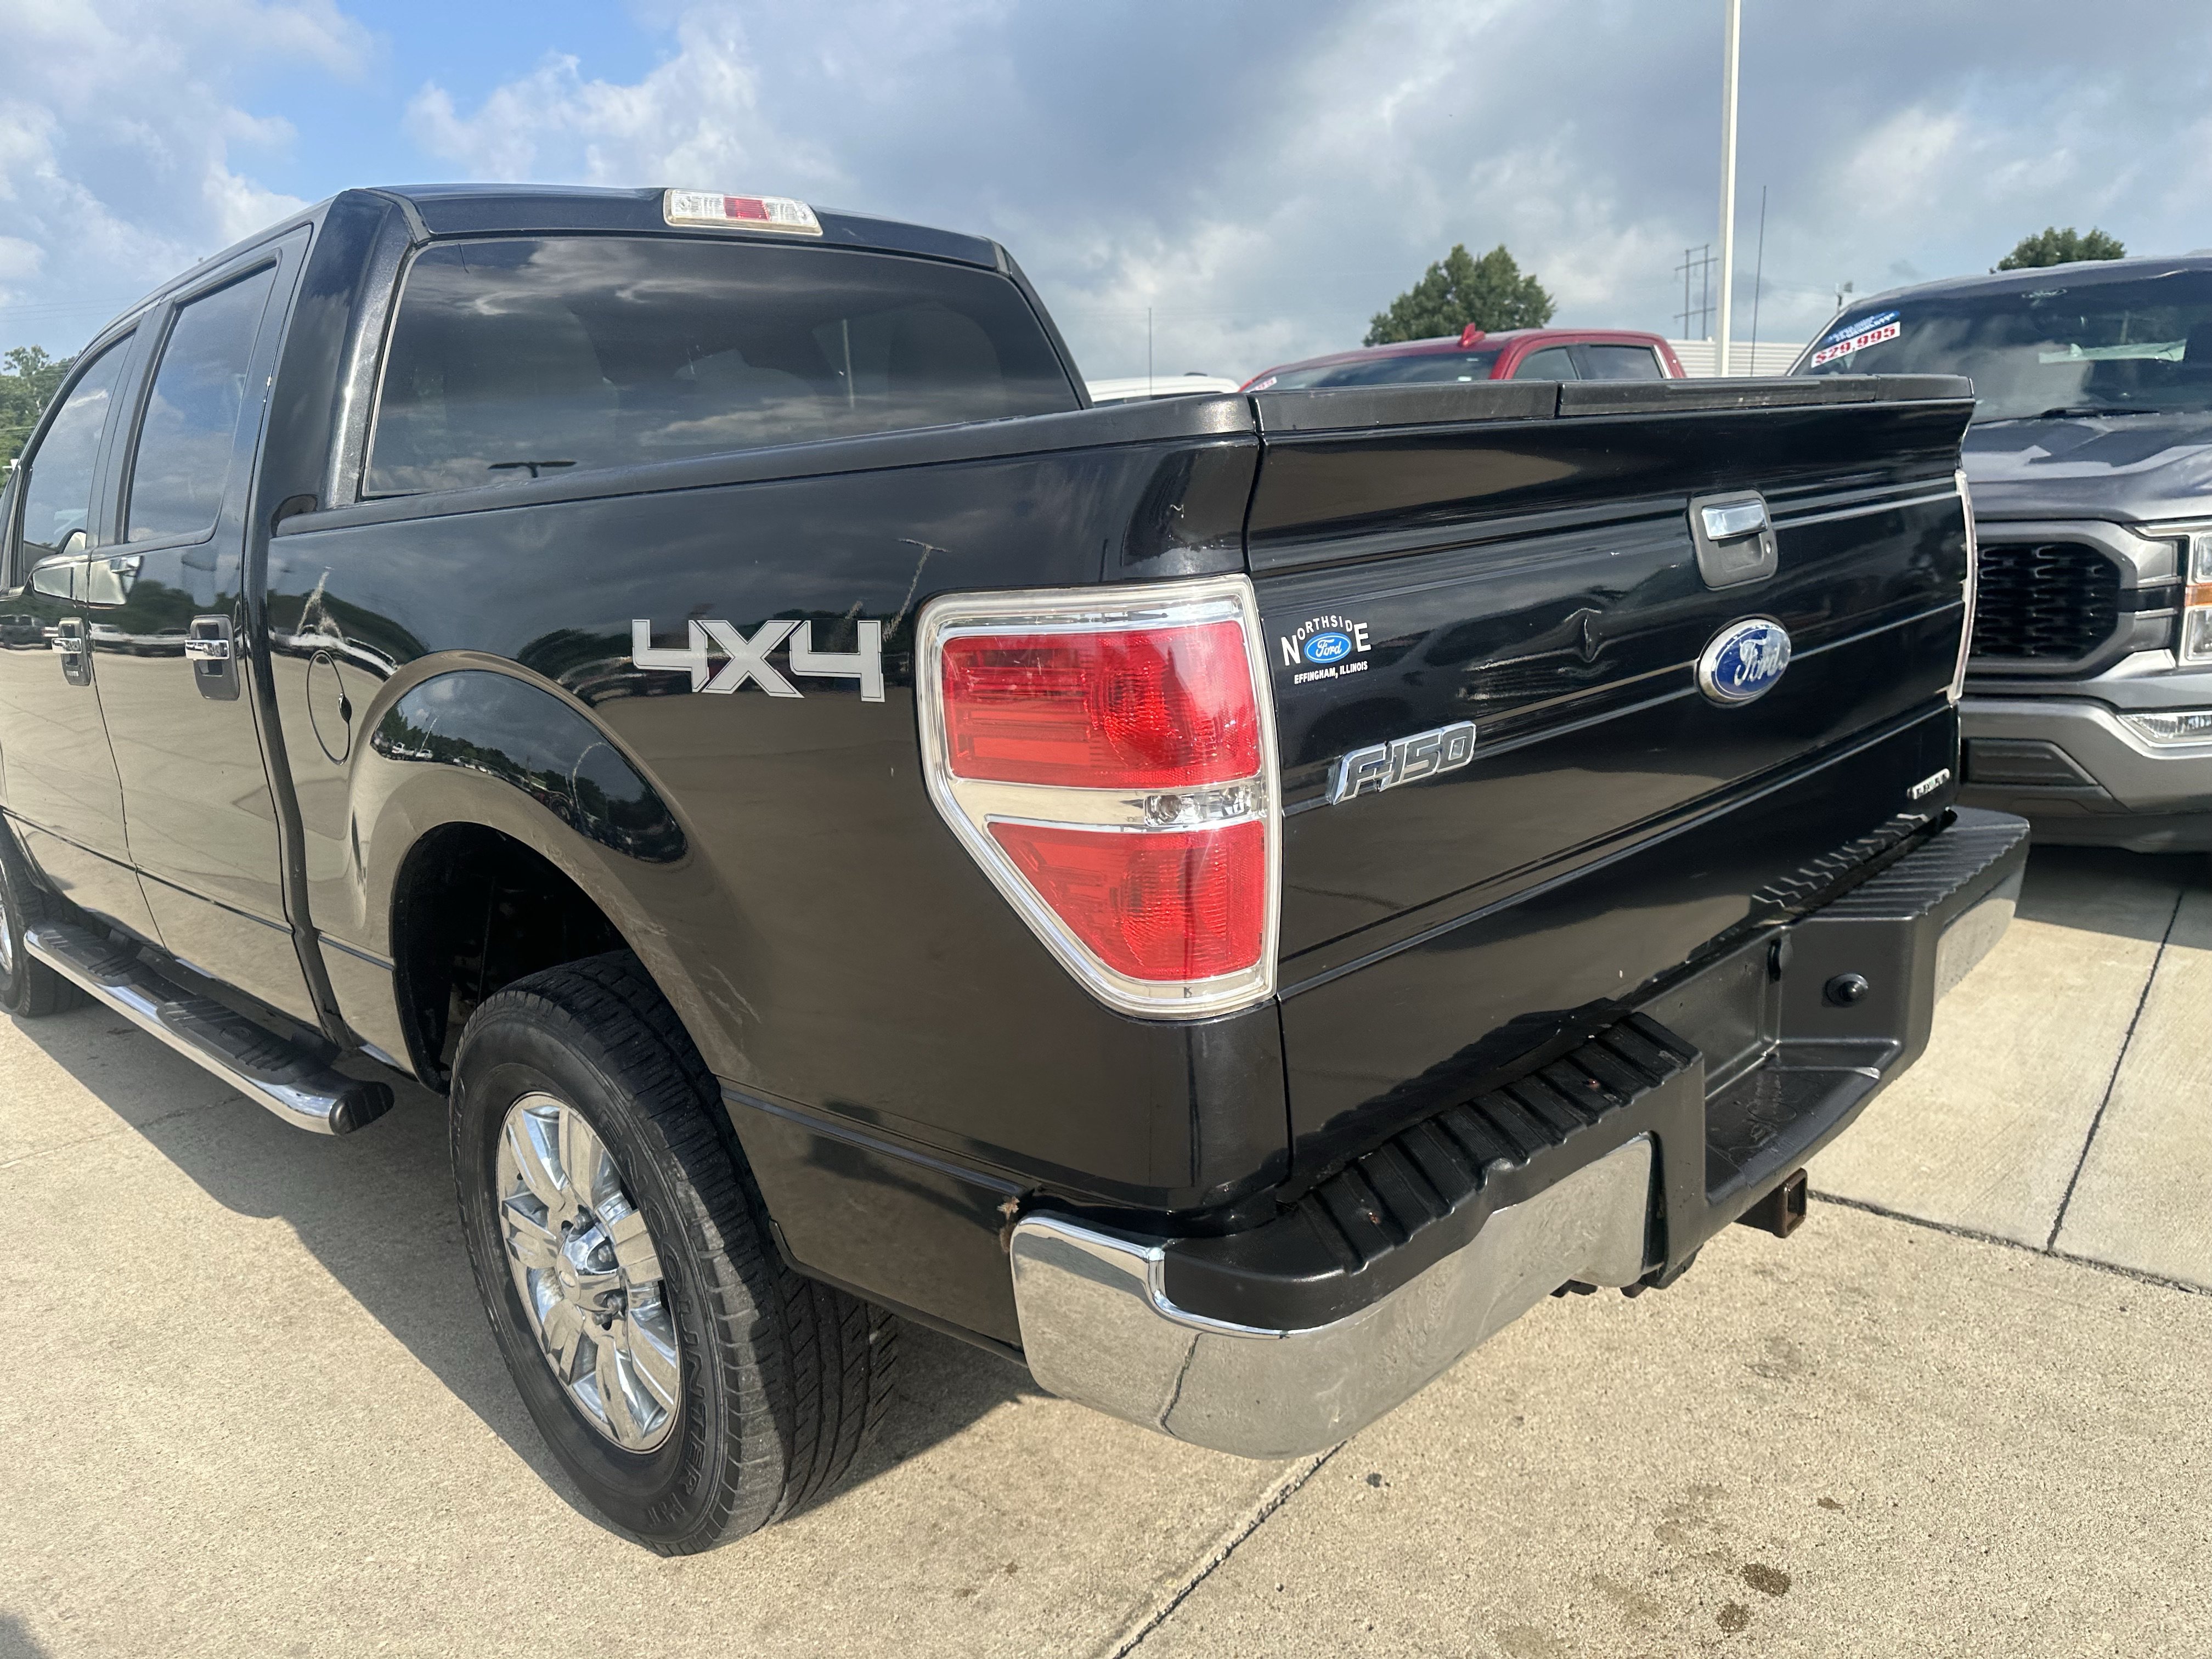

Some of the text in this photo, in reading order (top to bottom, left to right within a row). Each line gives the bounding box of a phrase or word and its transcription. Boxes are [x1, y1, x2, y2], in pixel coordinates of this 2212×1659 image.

[1815, 326, 1895, 363] $29,995
[1281, 615, 1371, 665] NORTHSIDE
[1316, 639, 1342, 657] Ford
[1294, 661, 1368, 684] EFFINGHAM, ILLINOIS
